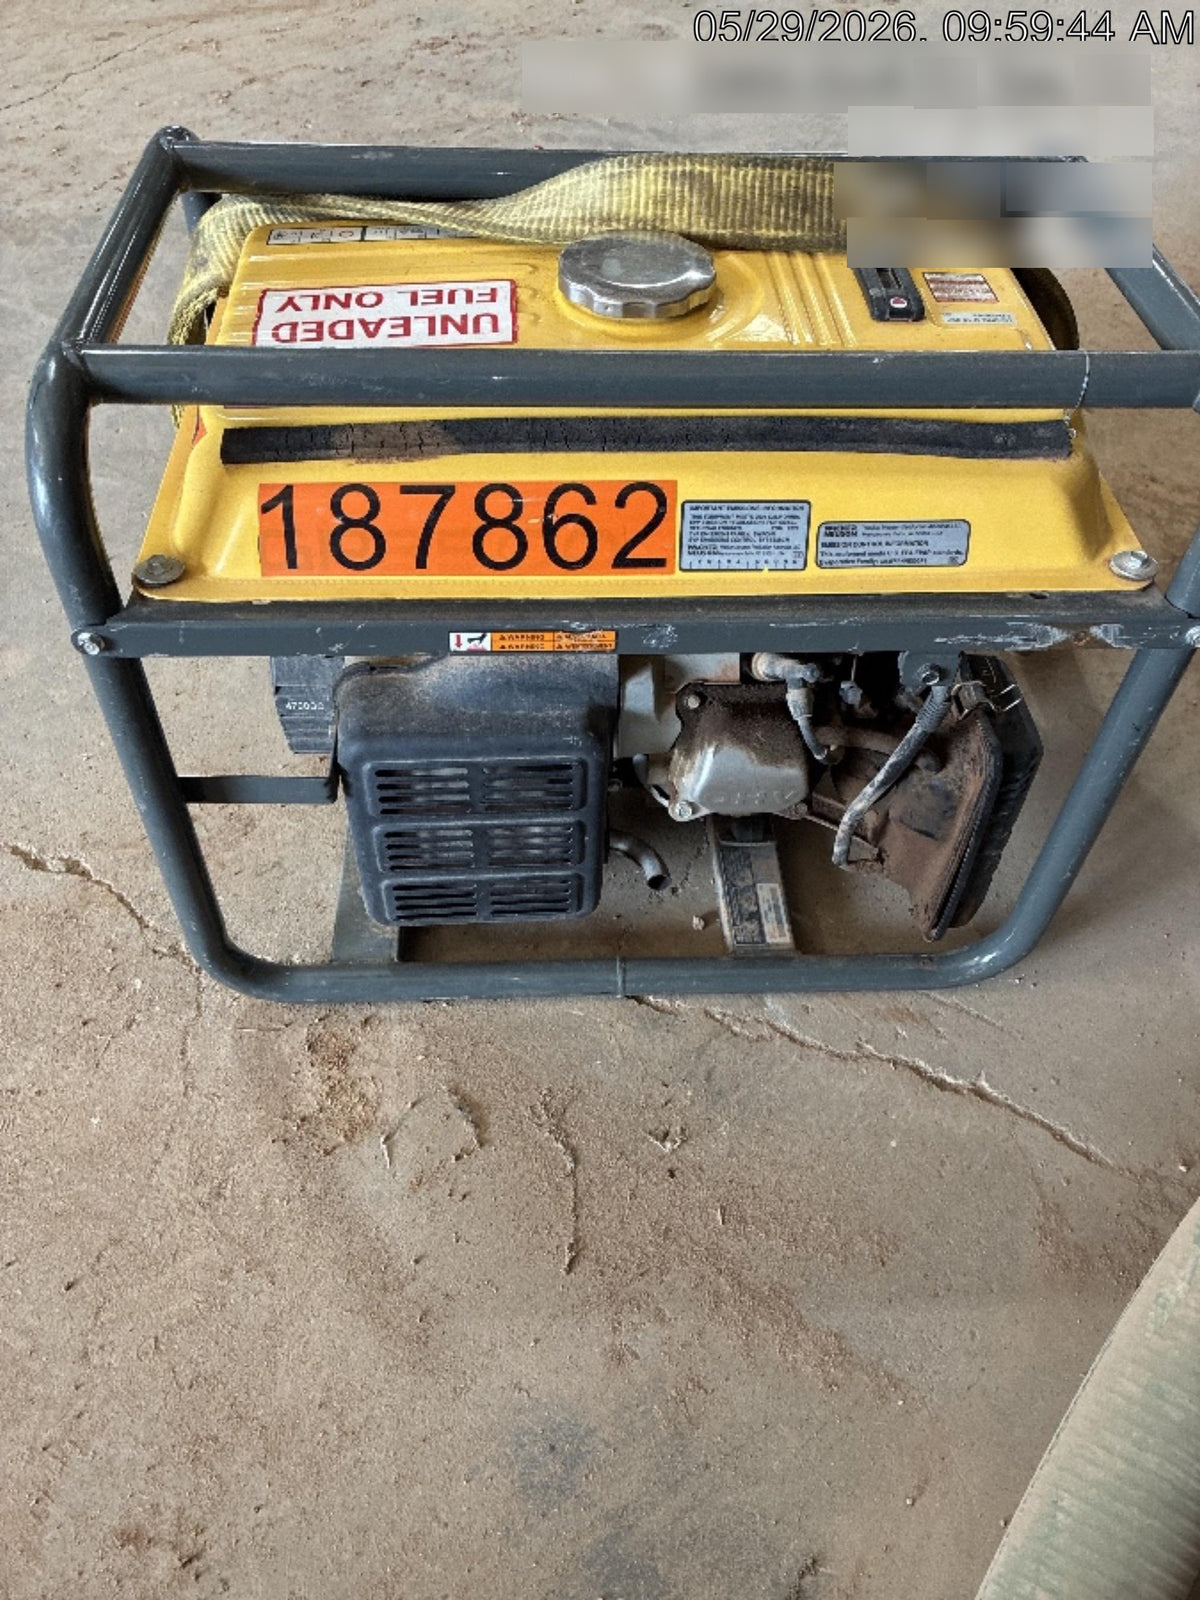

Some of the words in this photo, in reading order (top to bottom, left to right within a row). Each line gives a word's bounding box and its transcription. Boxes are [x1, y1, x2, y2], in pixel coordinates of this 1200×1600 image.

[275, 291, 384, 312] ONLY
[397, 287, 498, 306] FUEL
[271, 312, 500, 344] UNLEADED
[260, 480, 669, 571] 187862
